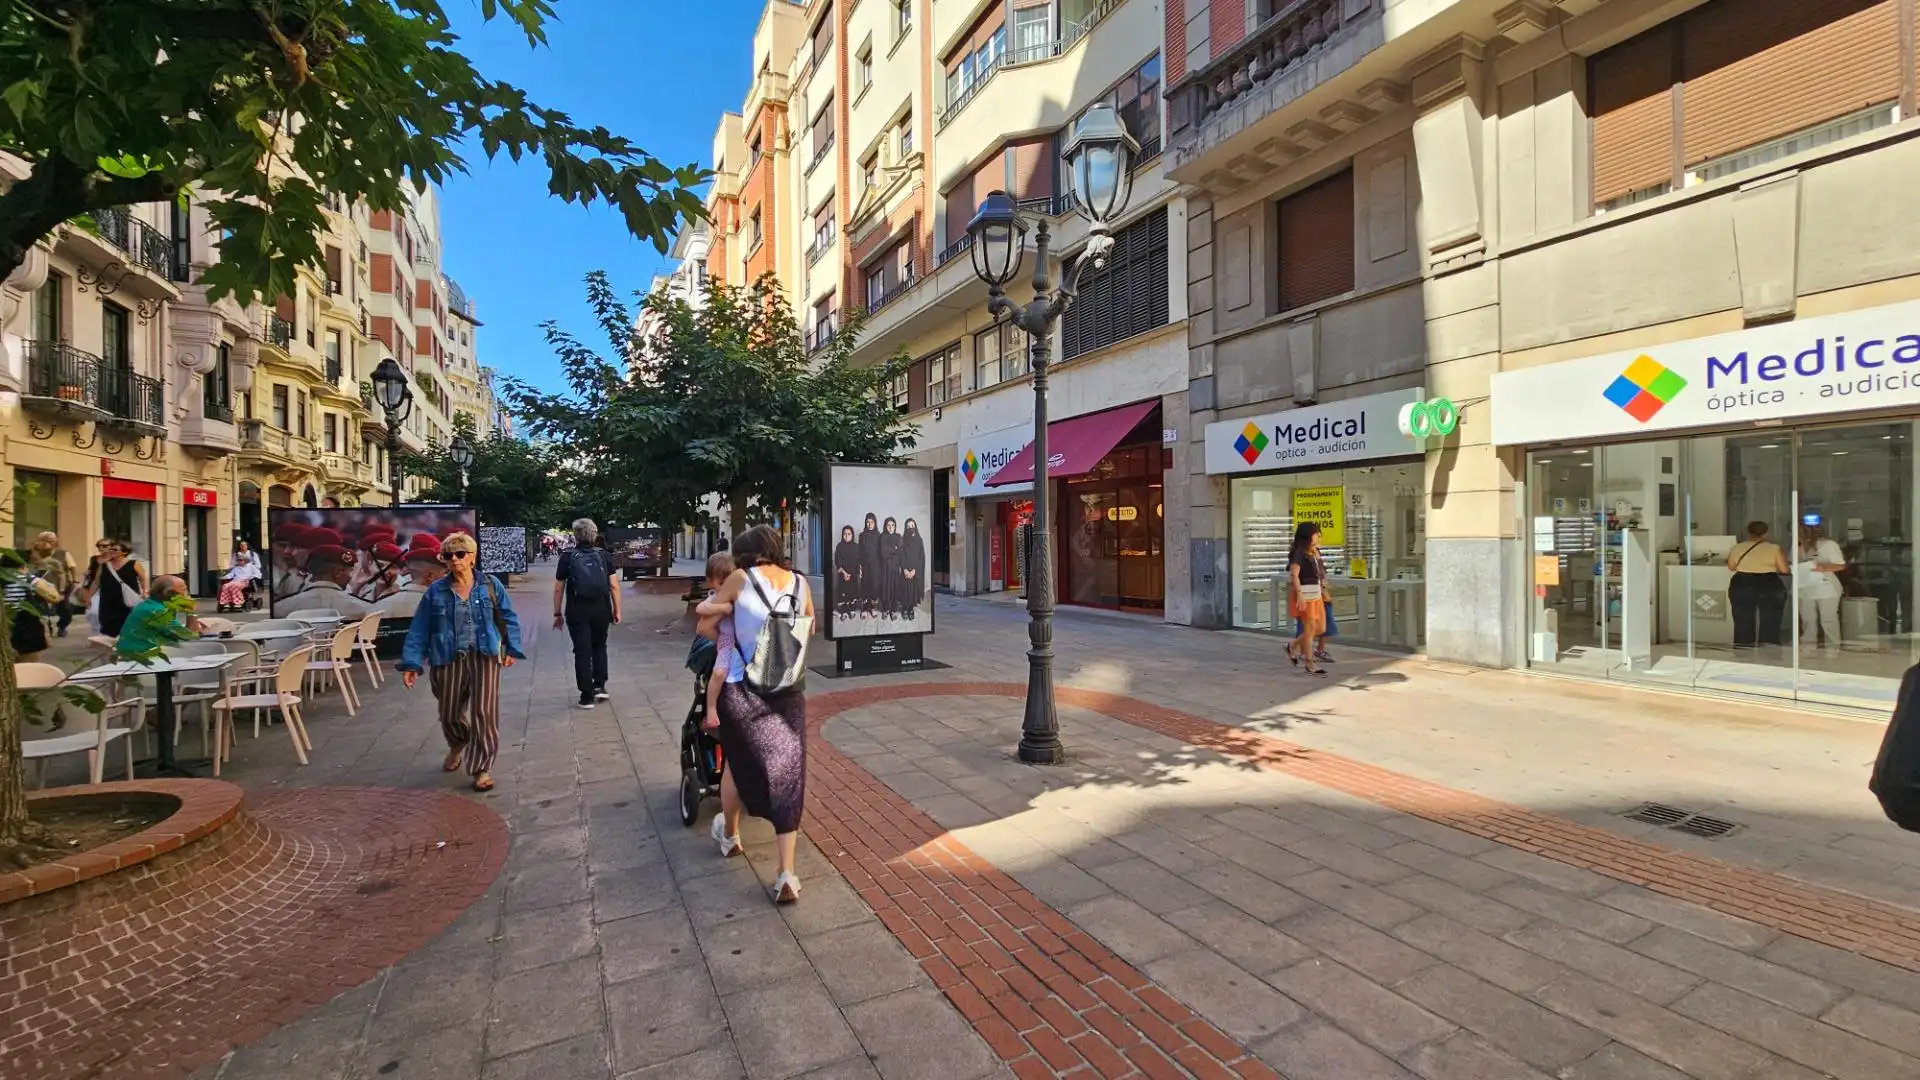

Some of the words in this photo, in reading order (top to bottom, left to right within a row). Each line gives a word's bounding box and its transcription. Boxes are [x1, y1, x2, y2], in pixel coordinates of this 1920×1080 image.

[1707, 389, 1785, 412] óptica
[1275, 411, 1365, 446] Medical
[981, 444, 1025, 470] Medic
[1318, 439, 1366, 455] audición
[1296, 510, 1332, 519] MISMOS
